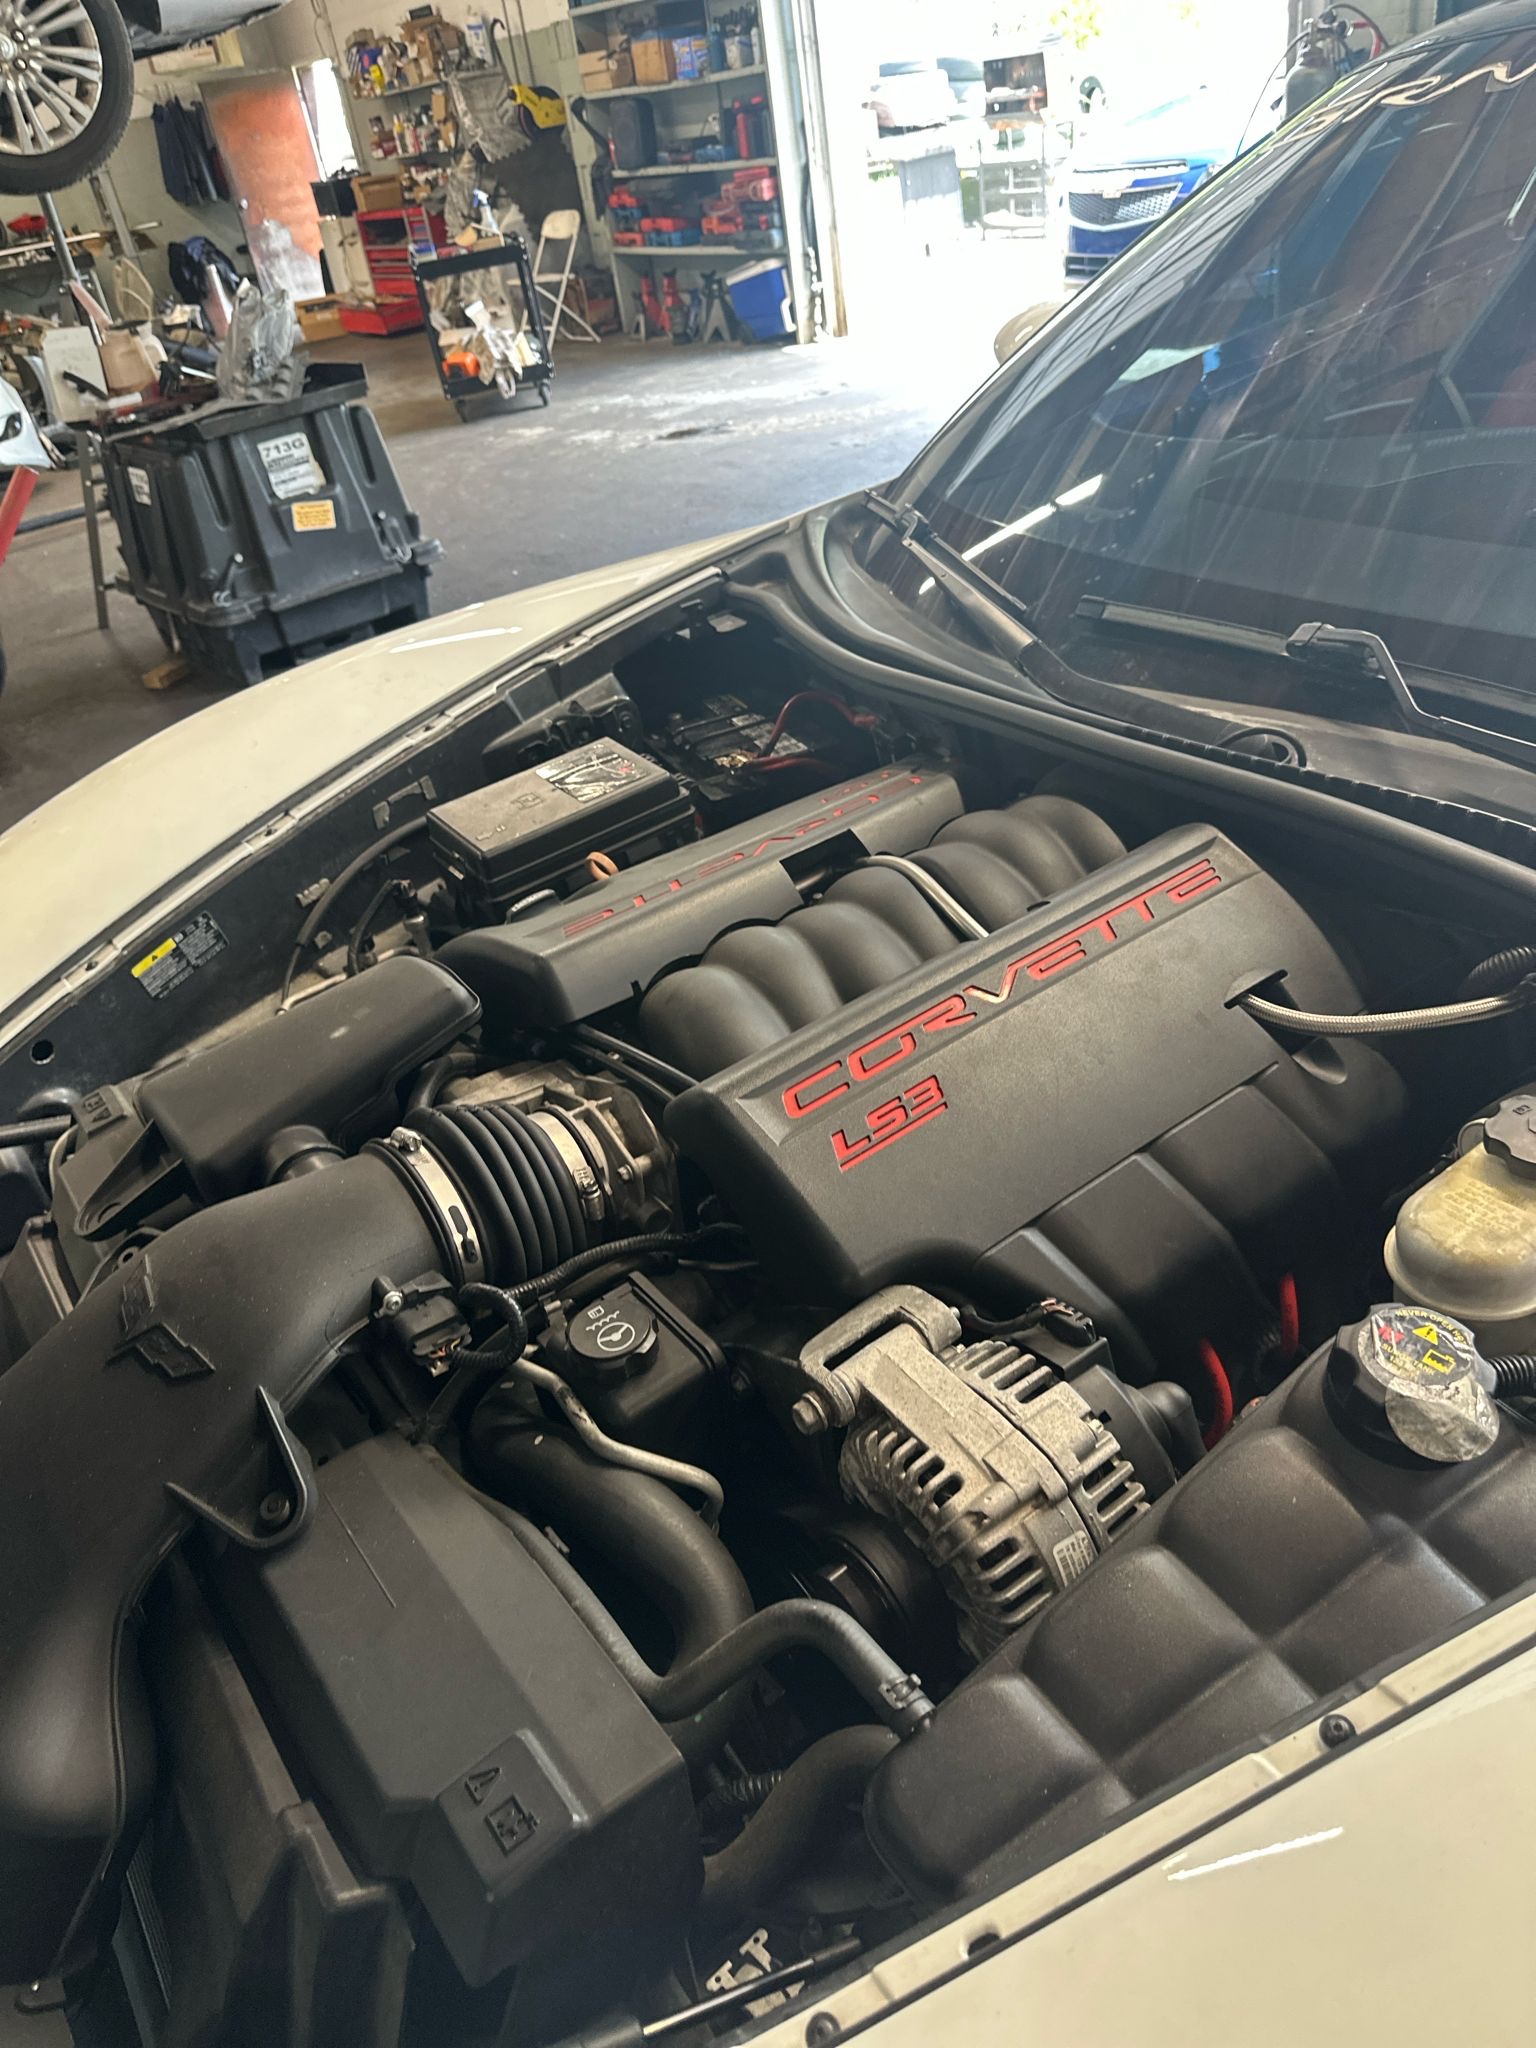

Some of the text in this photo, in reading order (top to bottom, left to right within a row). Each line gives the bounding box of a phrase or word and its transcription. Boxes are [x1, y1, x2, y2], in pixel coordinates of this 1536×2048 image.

[262, 437, 305, 458] 713G
[782, 863, 1221, 1119] CORVETTE
[831, 1075, 944, 1161] LS3
[1395, 1308, 1428, 1319] NEVER
[1429, 1314, 1453, 1331] OPEN
